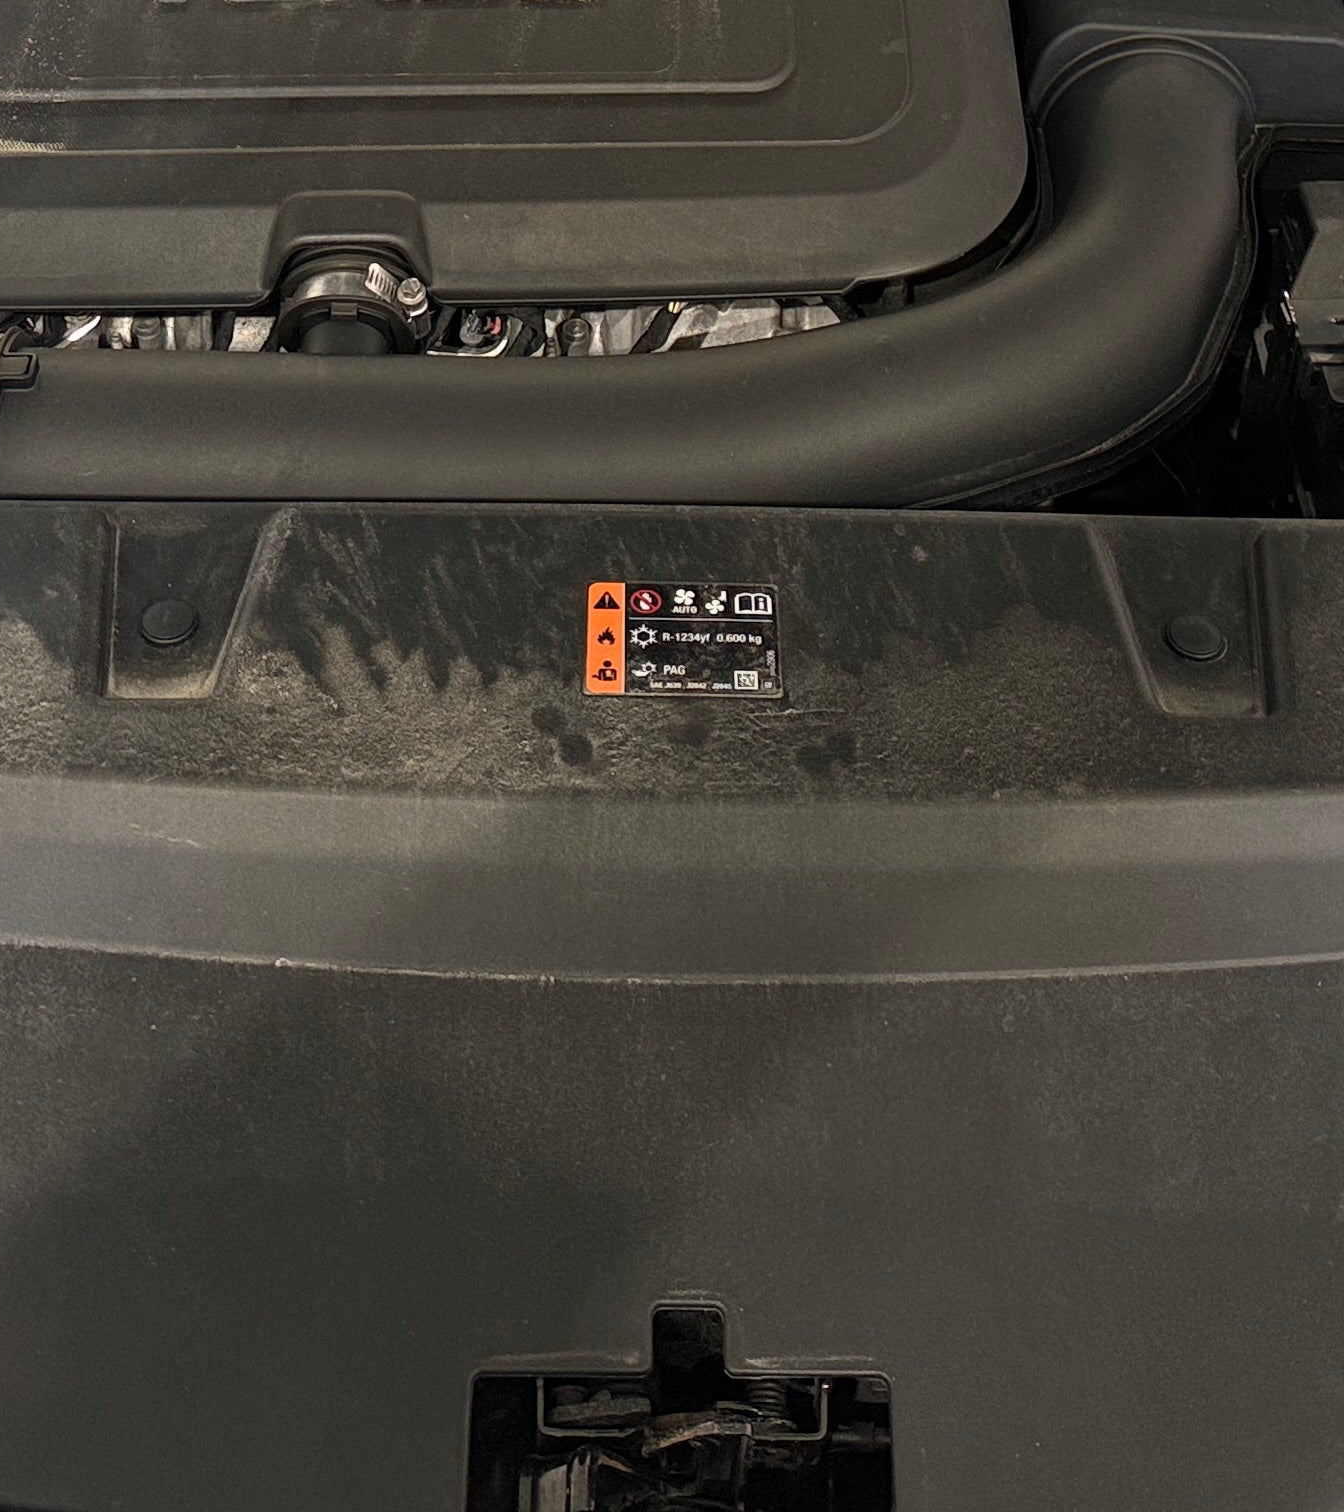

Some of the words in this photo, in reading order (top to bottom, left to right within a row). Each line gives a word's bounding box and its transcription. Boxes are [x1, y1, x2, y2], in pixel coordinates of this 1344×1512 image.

[672, 605, 698, 615] AUTO
[662, 632, 711, 644] R-1234yf
[716, 633, 747, 643] 0.600
[748, 633, 763, 645] kg
[663, 665, 686, 675] PAG
